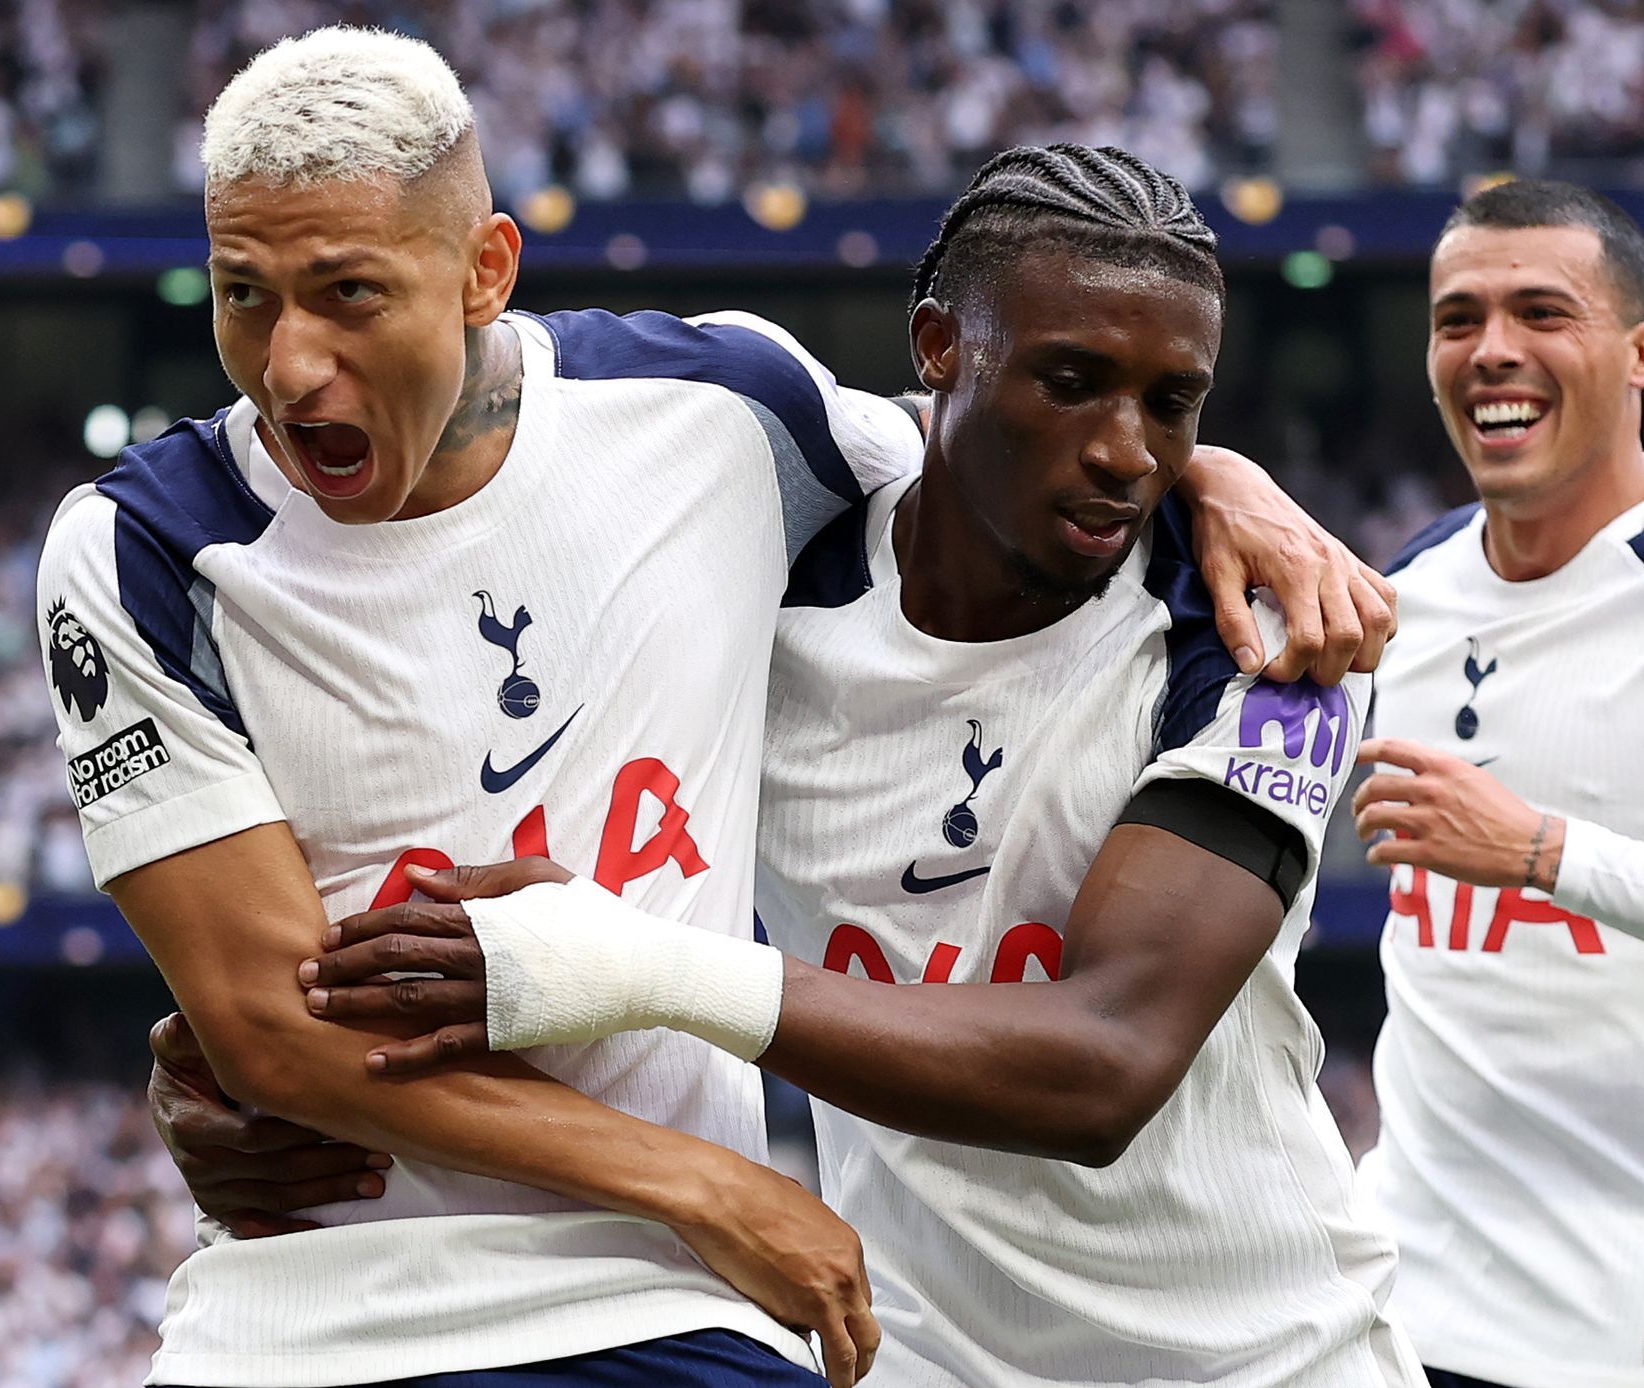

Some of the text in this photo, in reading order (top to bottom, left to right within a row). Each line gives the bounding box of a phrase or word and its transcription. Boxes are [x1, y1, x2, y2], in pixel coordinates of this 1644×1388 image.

[68, 730, 150, 783] No room
[74, 744, 169, 808] for racism
[1224, 757, 1331, 819] krake
